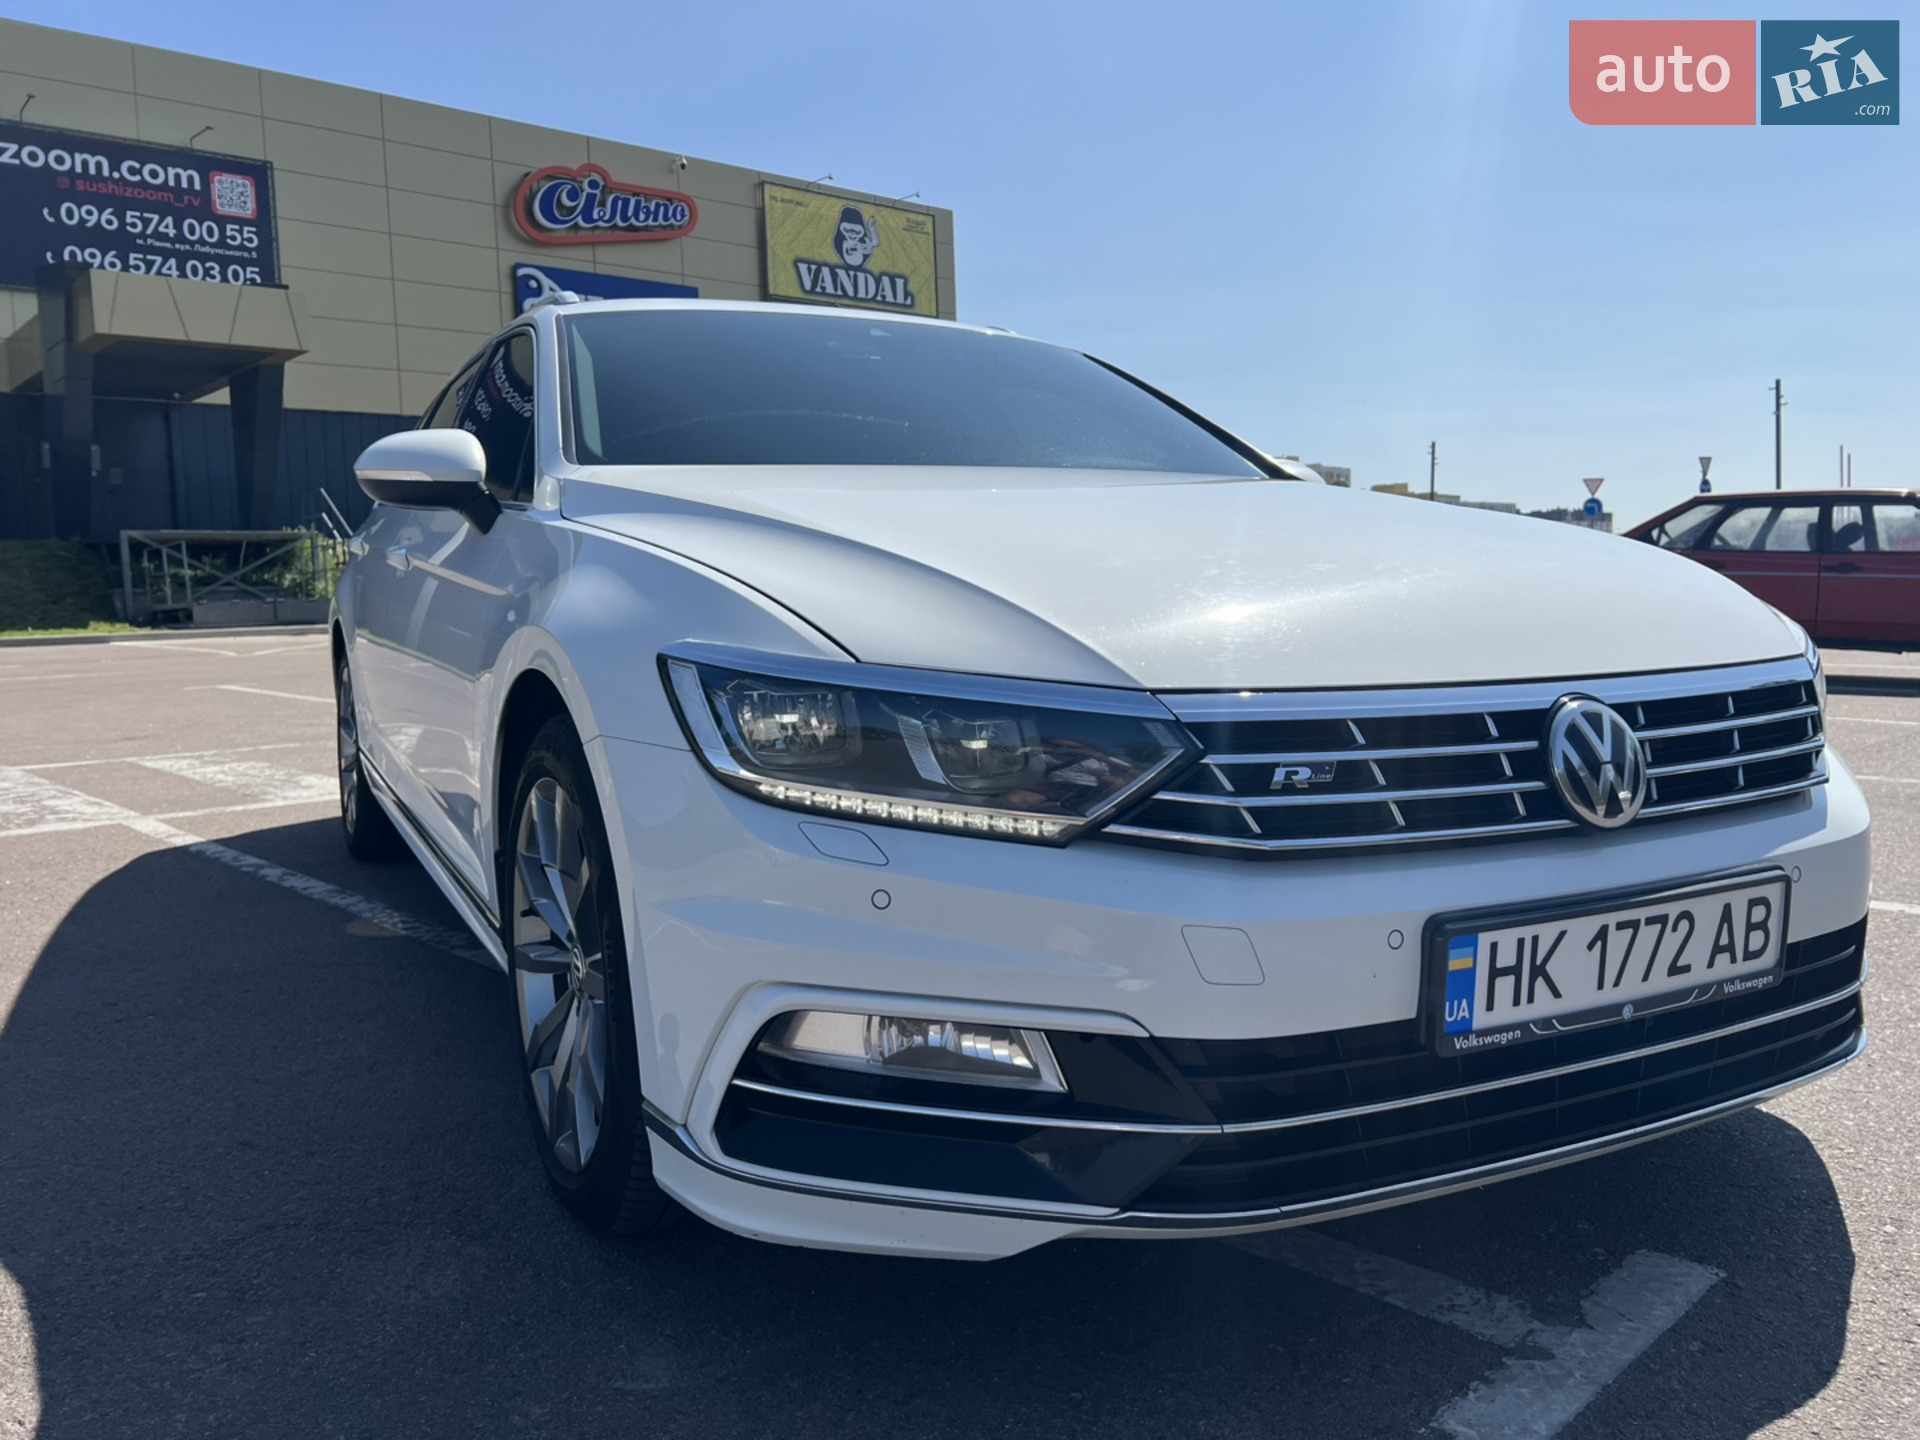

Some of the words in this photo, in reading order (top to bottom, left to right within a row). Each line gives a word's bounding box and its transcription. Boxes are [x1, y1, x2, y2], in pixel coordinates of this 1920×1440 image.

[0, 142, 201, 191] zoom.com
[75, 178, 201, 207] sushizoom_rv
[533, 177, 688, 229] Сільпо
[60, 202, 119, 231] 096
[125, 210, 177, 238] 574
[182, 218, 219, 243] 00
[225, 223, 259, 248] 55
[128, 252, 180, 279] 574
[185, 259, 221, 284] 03
[796, 261, 912, 305] VANDAL
[1270, 766, 1312, 789] R
[1485, 930, 1568, 1012] HK
[1586, 909, 1696, 991] 1772
[1706, 896, 1772, 970] AB
[1722, 973, 1774, 994] Volkswagen
[1444, 998, 1470, 1022] UA
[1454, 1028, 1521, 1050] Volkswagen
